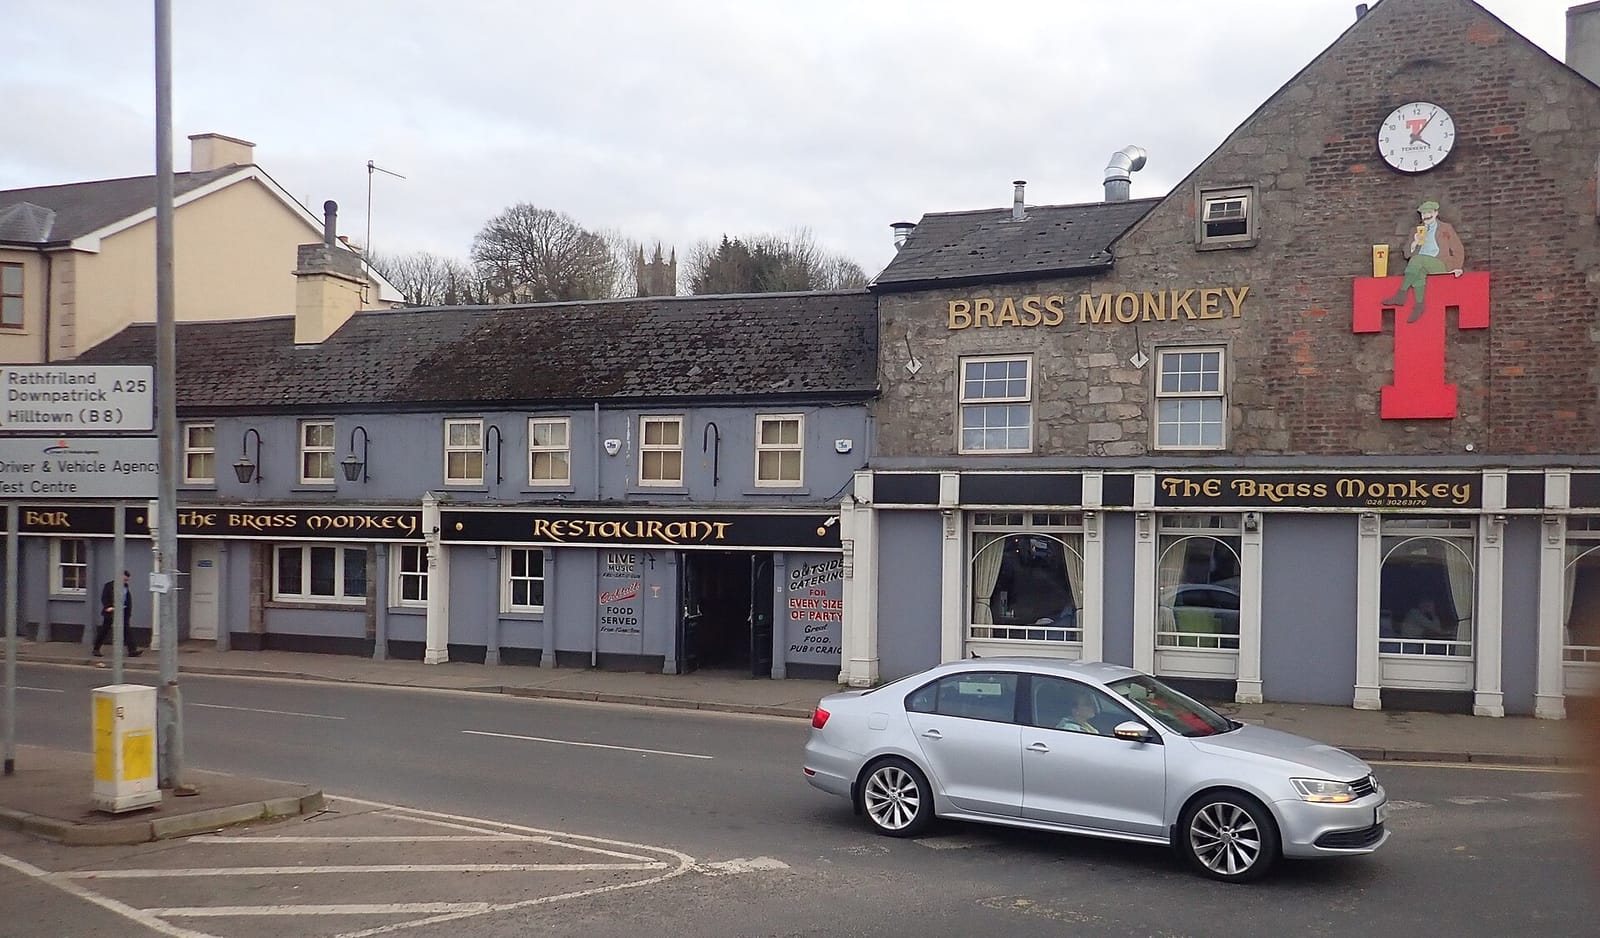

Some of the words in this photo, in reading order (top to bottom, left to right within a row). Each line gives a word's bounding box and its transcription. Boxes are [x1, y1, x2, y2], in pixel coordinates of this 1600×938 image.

[948, 296, 1065, 331] BRASS
[1079, 286, 1250, 325] MONKEY
[8, 372, 97, 386] Rathfriland
[112, 380, 147, 393] A25
[8, 389, 108, 404] Downpatrick
[8, 410, 73, 423] Hilltown
[41, 461, 52, 473] &
[58, 460, 106, 473] Vehicle
[112, 460, 160, 475] Agency
[30, 481, 77, 493] Centre
[608, 553, 636, 565] LIVE
[608, 565, 635, 573] MUSIC
[791, 557, 843, 580] OUTSIDE
[809, 589, 827, 597] FOR
[607, 606, 634, 615] FOOD
[789, 598, 819, 609] EVERY
[821, 599, 843, 611] SIZE
[601, 616, 638, 625] SERVED
[791, 610, 806, 621] OF
[808, 611, 843, 623] PARTY
[804, 624, 828, 634] Great
[789, 644, 809, 654] PUB
